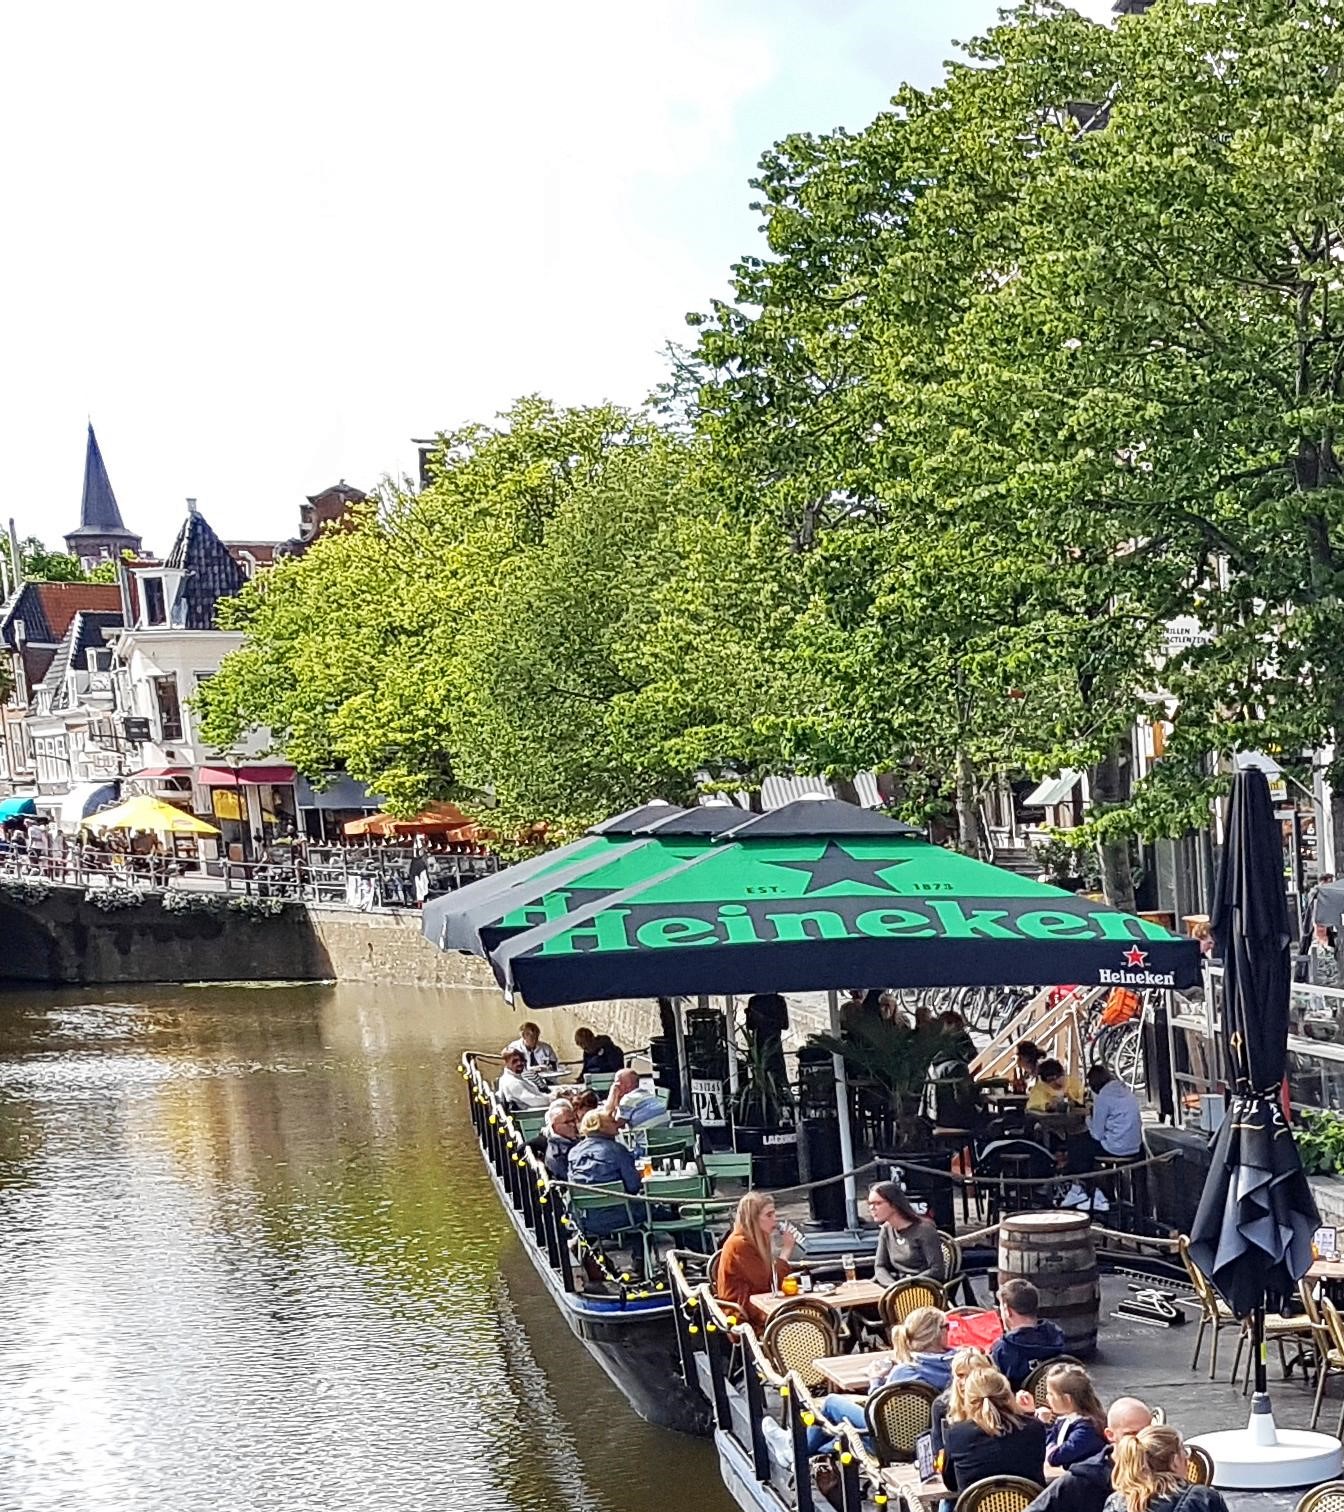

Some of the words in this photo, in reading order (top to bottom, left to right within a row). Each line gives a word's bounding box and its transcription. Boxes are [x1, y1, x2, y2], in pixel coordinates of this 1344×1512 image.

[746, 886, 787, 895] EST.
[534, 899, 1184, 956] Heineken
[1099, 969, 1175, 985] Heineken
